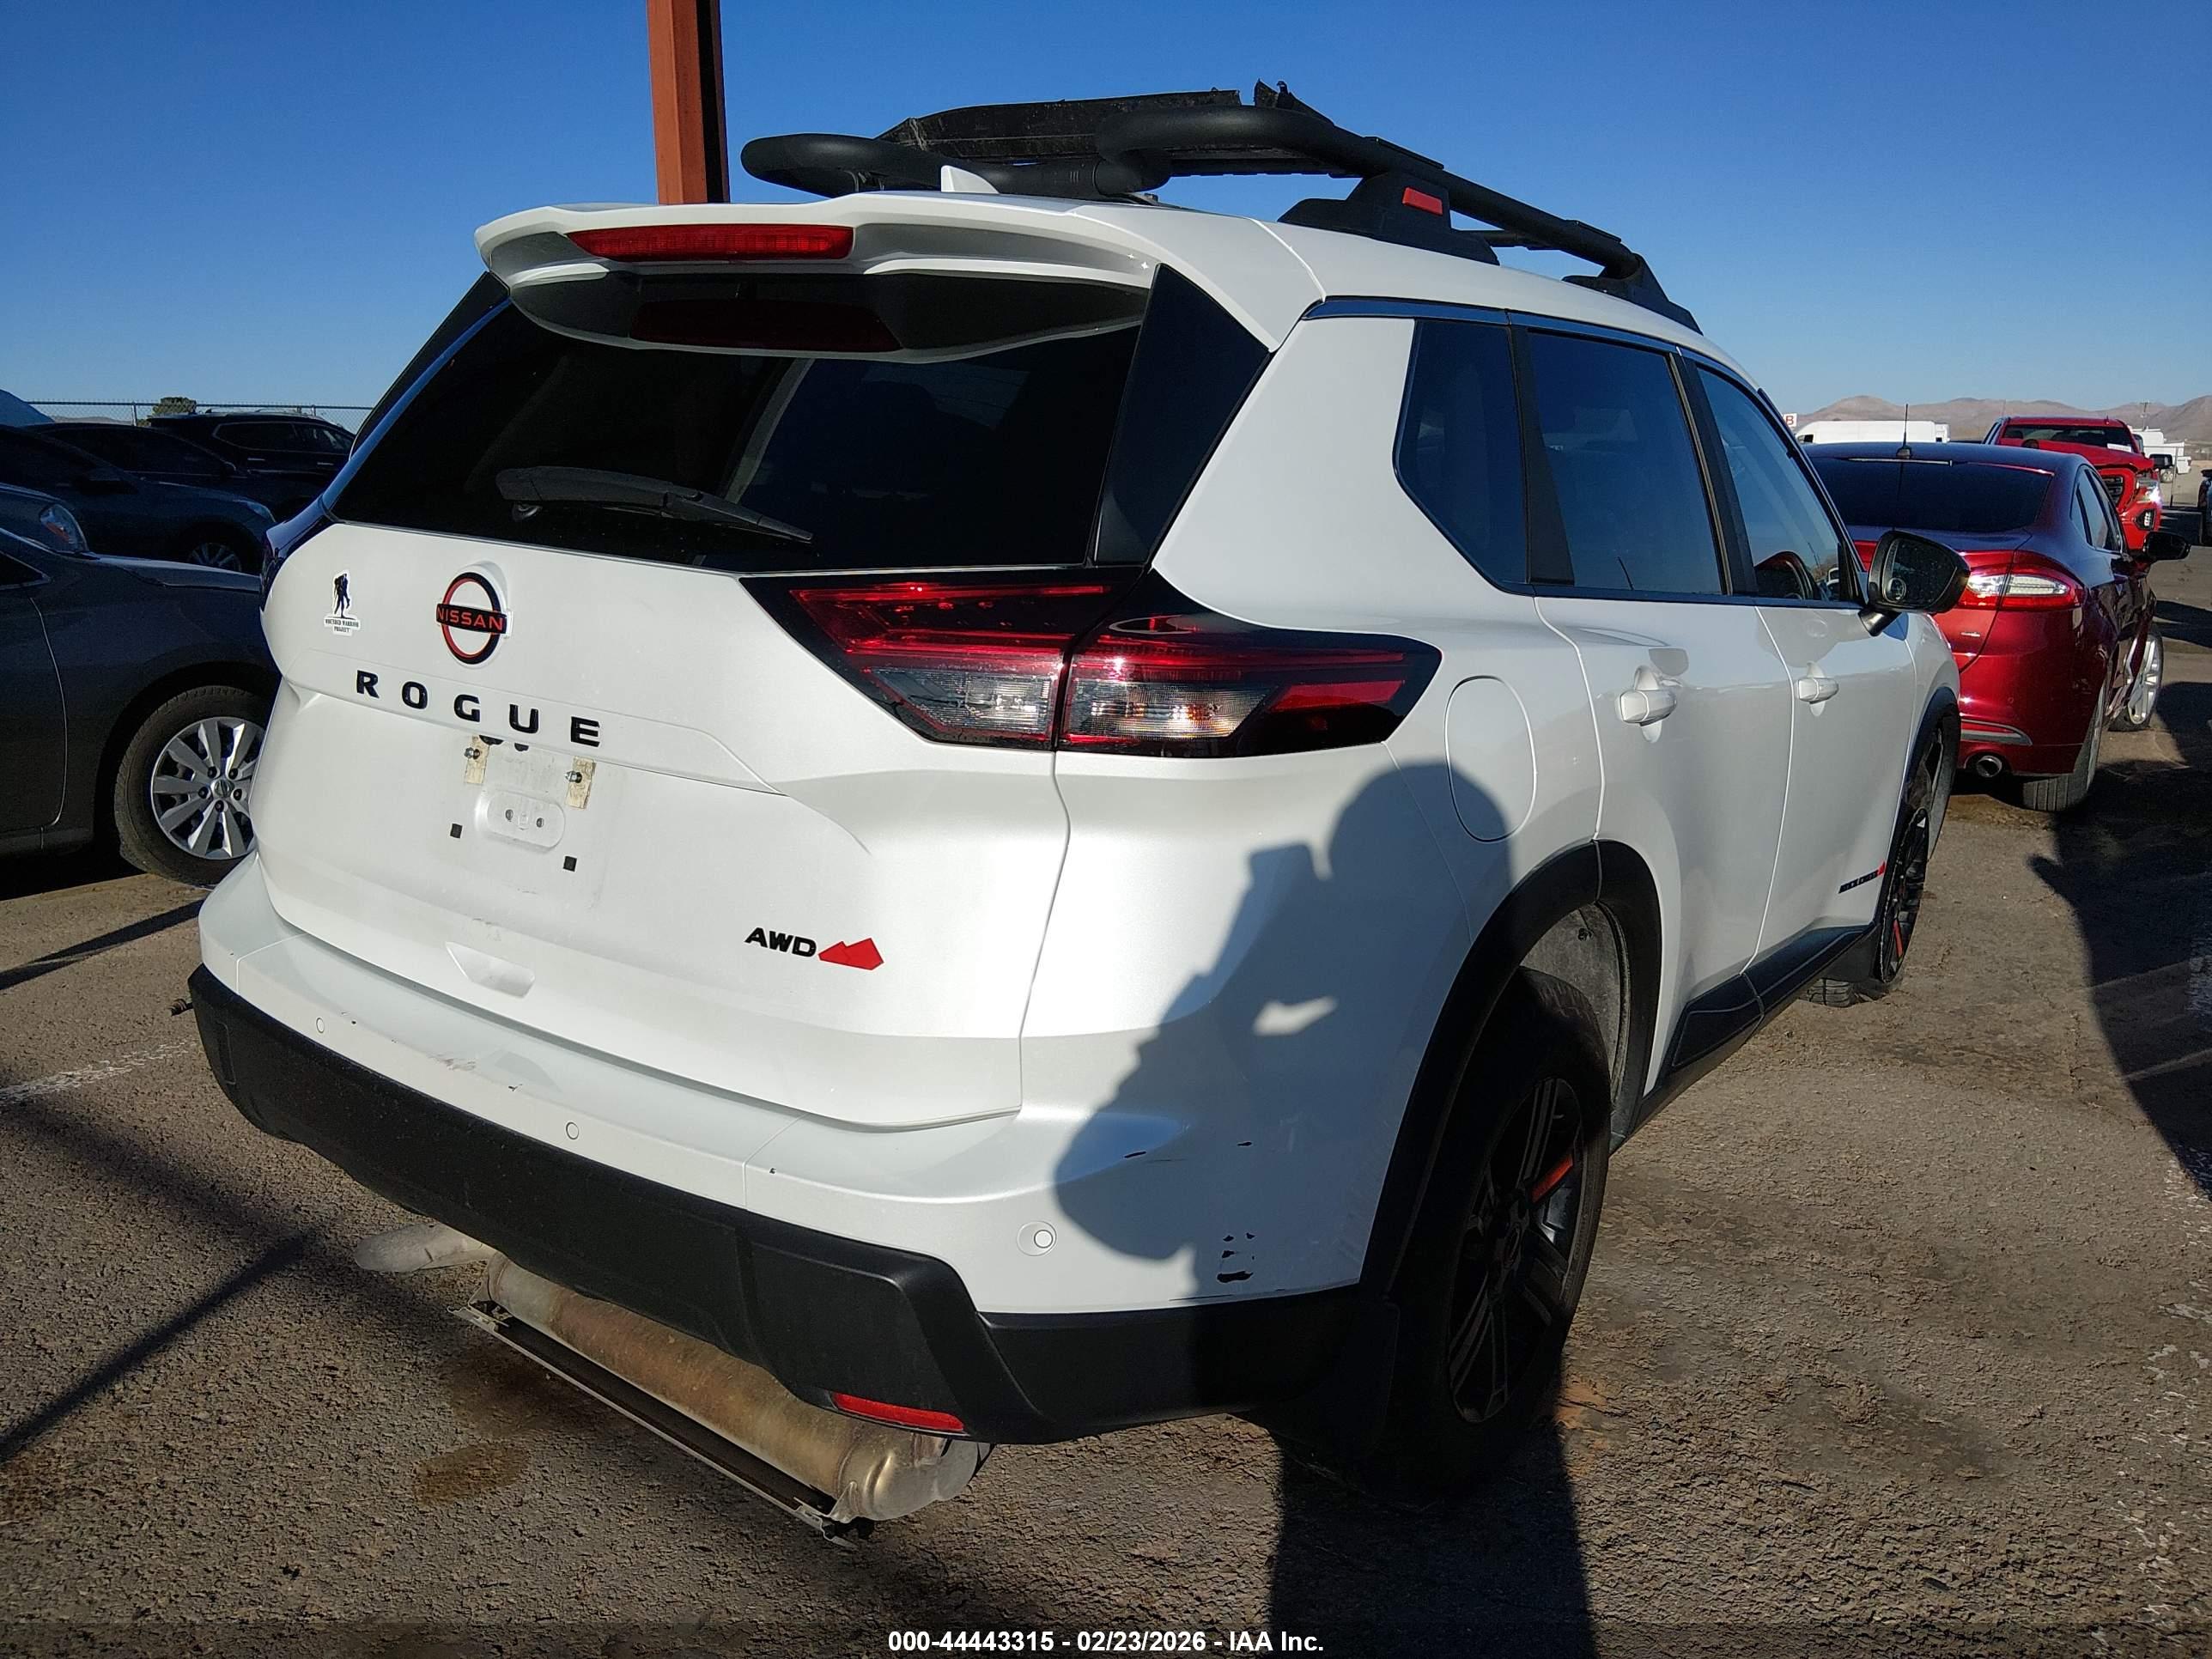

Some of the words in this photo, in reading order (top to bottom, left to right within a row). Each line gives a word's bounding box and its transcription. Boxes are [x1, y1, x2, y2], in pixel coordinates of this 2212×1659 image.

[436, 606, 505, 631] NISSAN
[356, 670, 601, 748] ROGUE
[744, 927, 817, 957] AWD
